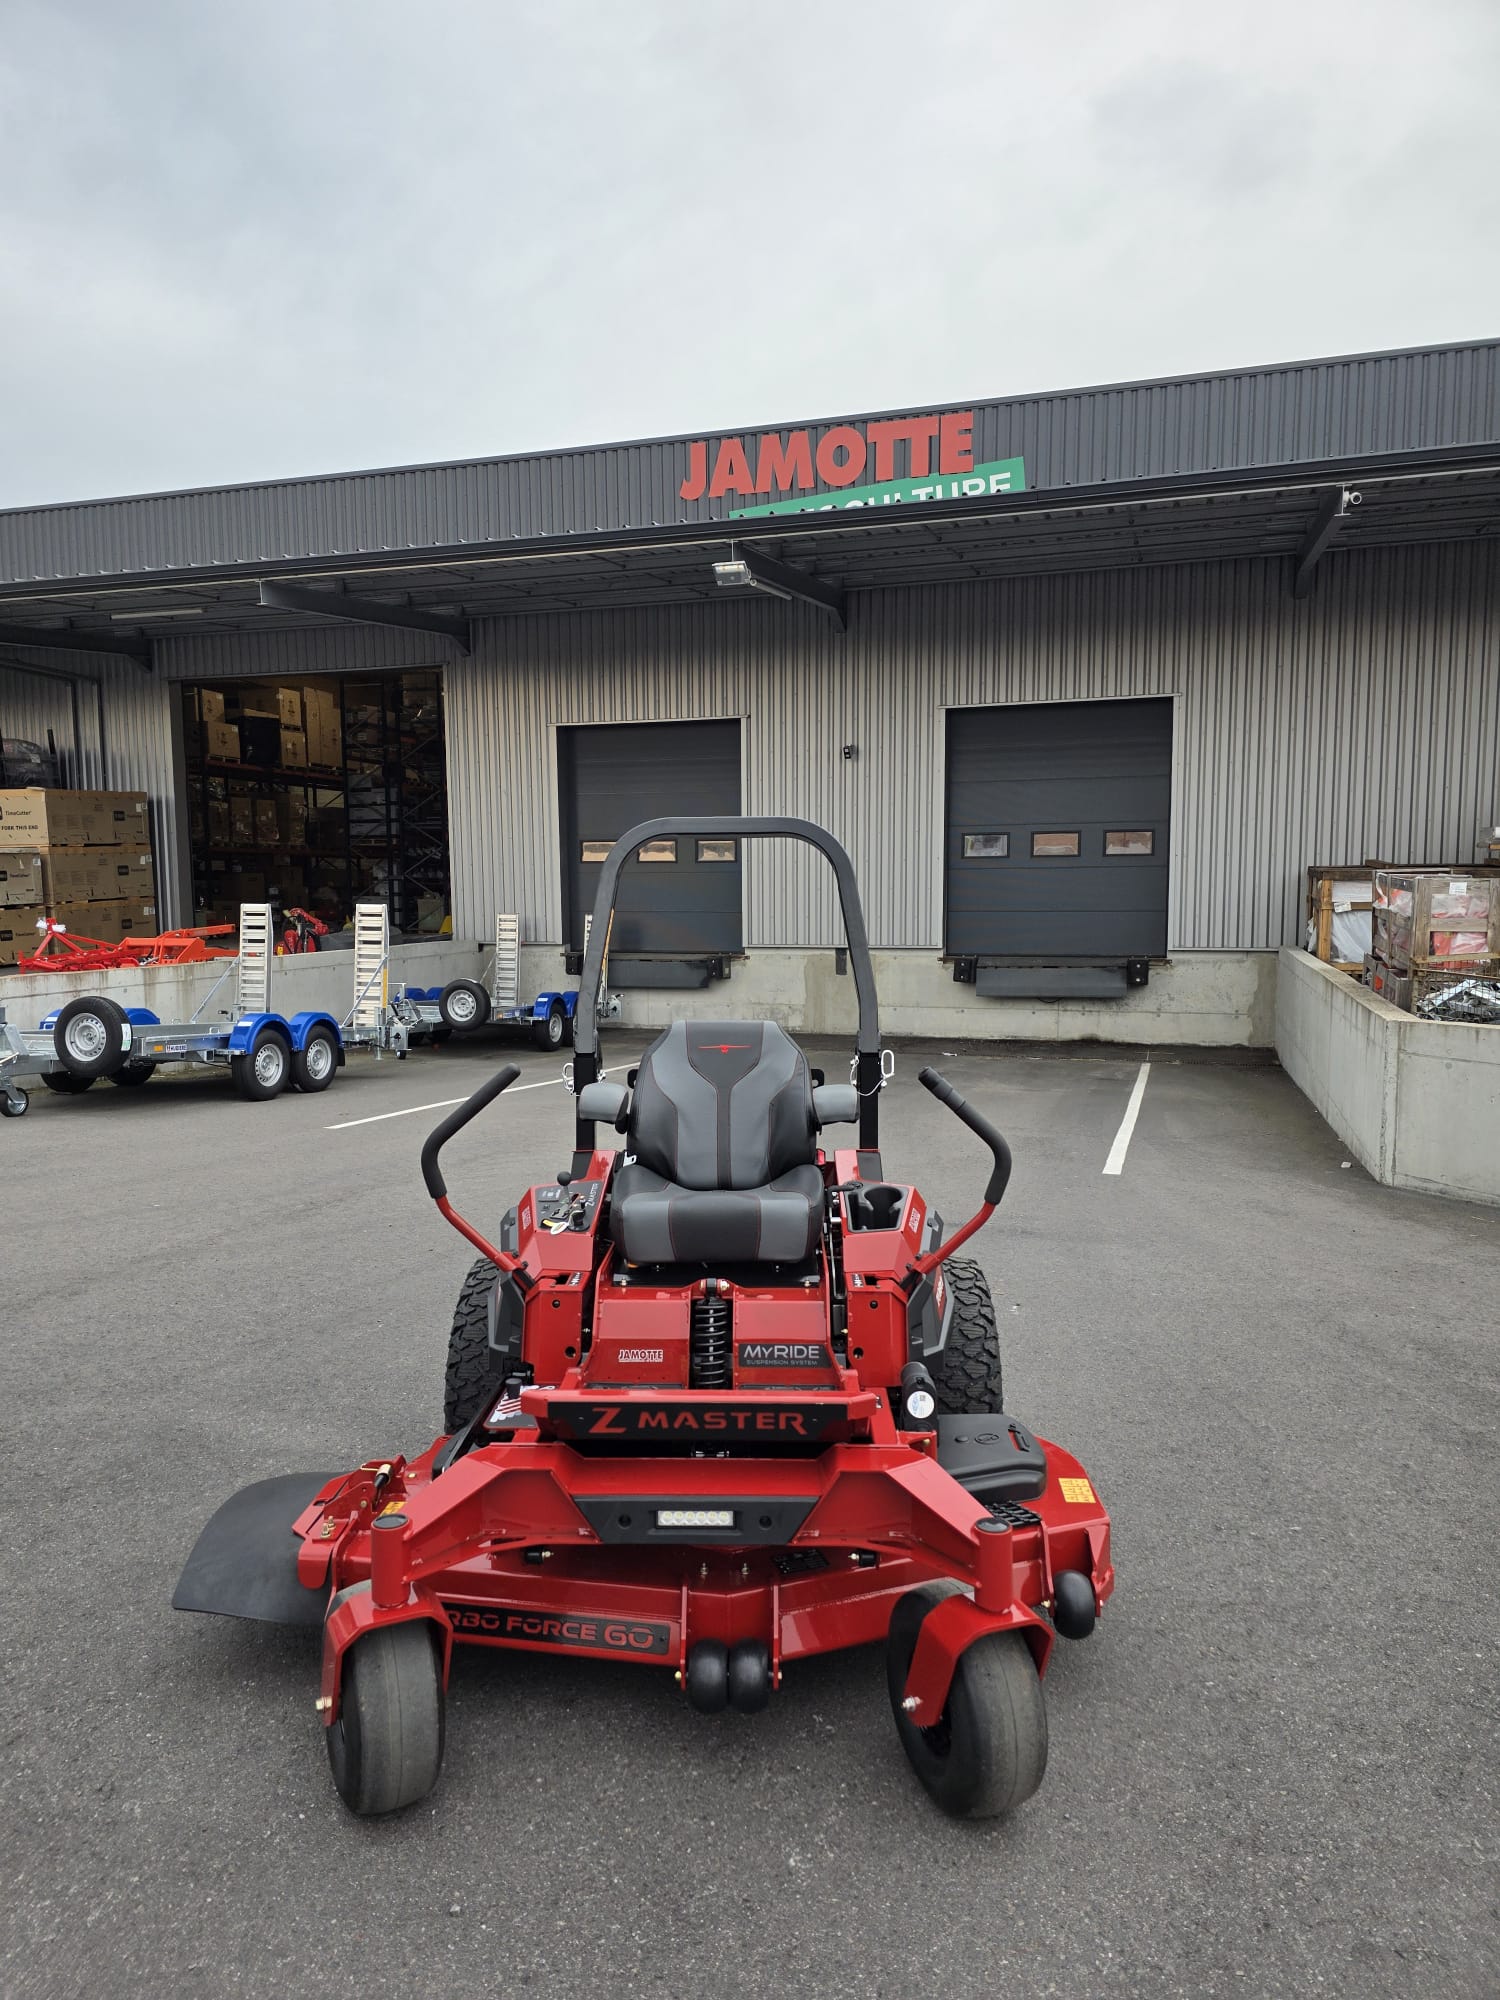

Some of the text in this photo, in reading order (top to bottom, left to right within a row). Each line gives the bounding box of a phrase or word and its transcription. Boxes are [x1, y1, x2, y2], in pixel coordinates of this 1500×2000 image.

[680, 411, 974, 500] JAMOTTE
[618, 1350, 663, 1360] JAMOTTE
[588, 1407, 808, 1435] Z MASTER
[447, 1609, 500, 1629] RBO
[506, 1615, 598, 1641] FORCE
